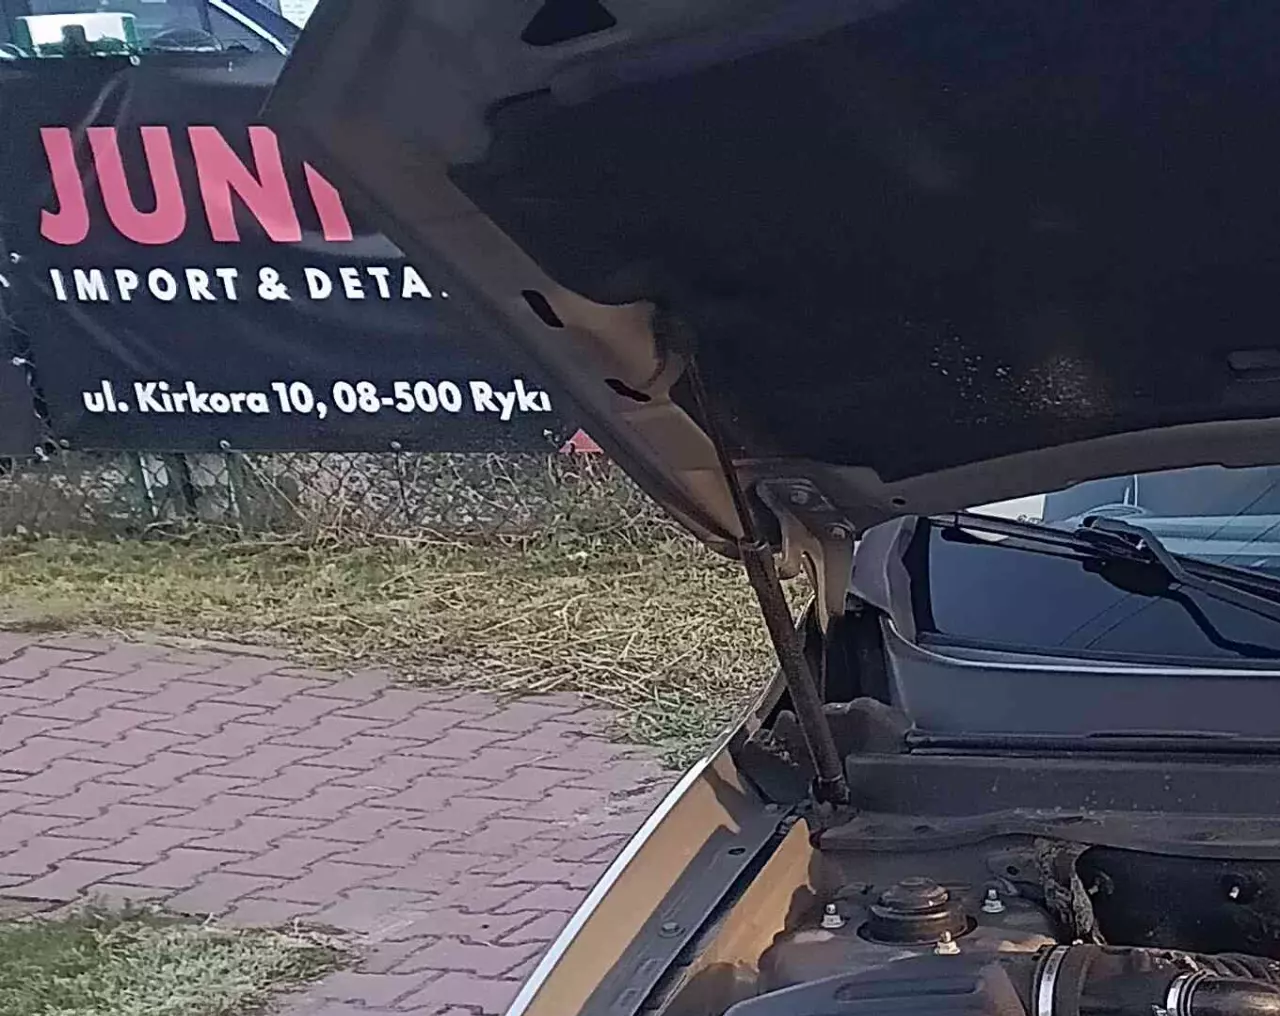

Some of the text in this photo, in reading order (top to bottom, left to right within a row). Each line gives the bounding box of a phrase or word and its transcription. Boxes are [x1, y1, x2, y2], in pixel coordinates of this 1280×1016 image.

[49, 267, 238, 301] IMPORT
[257, 266, 292, 301] &
[82, 380, 129, 412] ul.
[133, 381, 270, 413] Kirkora
[271, 381, 328, 419] 10,
[332, 381, 462, 413] 08-500
